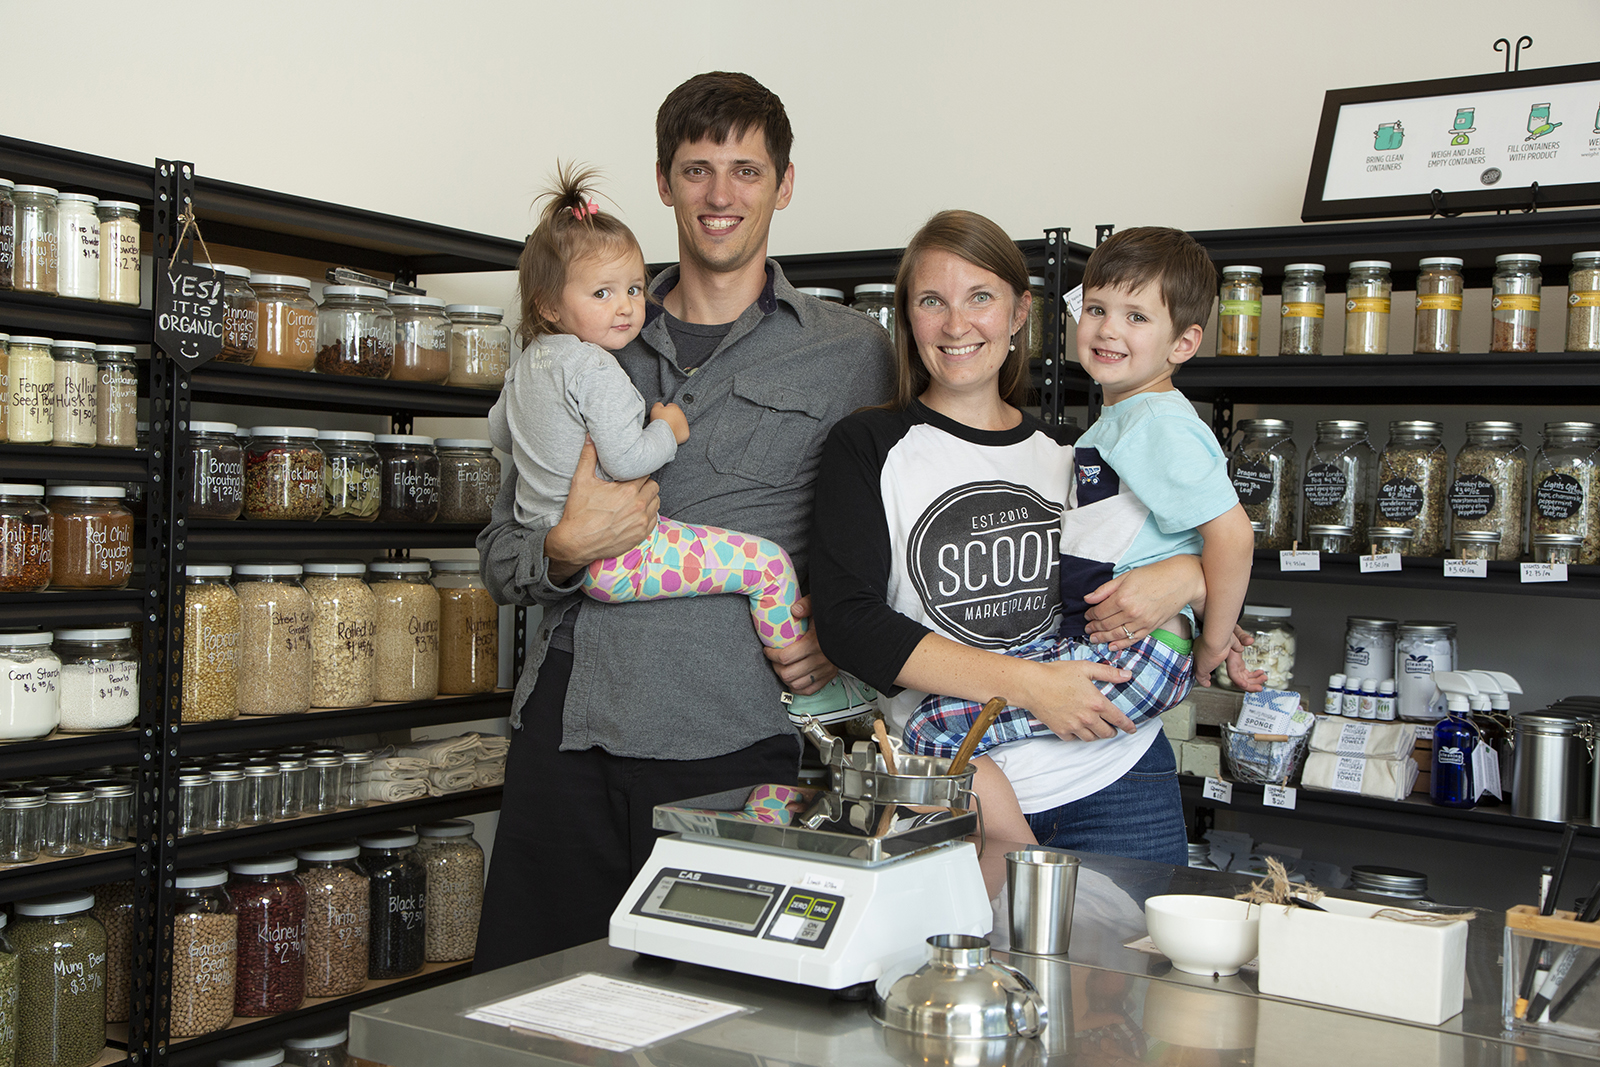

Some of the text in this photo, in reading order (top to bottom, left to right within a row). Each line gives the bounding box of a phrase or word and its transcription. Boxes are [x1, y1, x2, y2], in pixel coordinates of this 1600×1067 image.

[1431, 147, 1486, 159] WEIGH AND LABEL
[1507, 141, 1560, 153] FILL CONTAINERS
[1366, 154, 1404, 164] BRING CLEAN
[1428, 156, 1486, 168] EMPTY CONTAINERS
[1509, 150, 1558, 161] WITH PRODUCT
[1366, 162, 1402, 172] CONTAINERS
[167, 271, 222, 306] YES!
[172, 300, 212, 317] IT IS
[158, 313, 223, 339] ORGANIC
[225, 318, 254, 333] Sticks
[420, 324, 446, 341] Nutmeg
[471, 348, 496, 362] Root
[12, 391, 39, 407] Seed
[56, 393, 86, 408] Husk
[282, 463, 319, 485] Pickling
[332, 462, 379, 484] Bay Leaf
[394, 469, 421, 486] Elder
[457, 467, 494, 487] English
[1236, 467, 1258, 477] Dragon
[1307, 470, 1325, 478] Green
[199, 472, 241, 493] Sprouting
[1233, 480, 1261, 490] Green Tea
[1399, 484, 1418, 494] Stuff
[1478, 480, 1491, 488] Bear
[1543, 480, 1564, 490] Lights
[1239, 486, 1253, 496] Leaf
[86, 524, 130, 544] Red Chili
[94, 541, 132, 560] Powder
[964, 594, 1049, 621] MARKETPLACE
[271, 611, 297, 626] Steel
[337, 620, 366, 640] Rolled
[88, 663, 115, 675] Small
[1406, 661, 1432, 669] cleaning
[8, 669, 33, 681] Corn
[108, 673, 130, 684] Pearls
[1244, 717, 1274, 730] SPONGE
[1439, 752, 1463, 760] cleaning
[1336, 774, 1361, 782] TOWELS
[1272, 798, 1285, 806] $20
[678, 871, 702, 881] CAS
[389, 895, 416, 913] Black
[790, 901, 831, 915] ZERO TARE
[328, 903, 357, 928] Pinto
[257, 921, 299, 943] Kidney
[807, 922, 819, 930] ON
[801, 930, 816, 939] OFF
[53, 959, 84, 978] Mung
[200, 956, 229, 974] Bean
